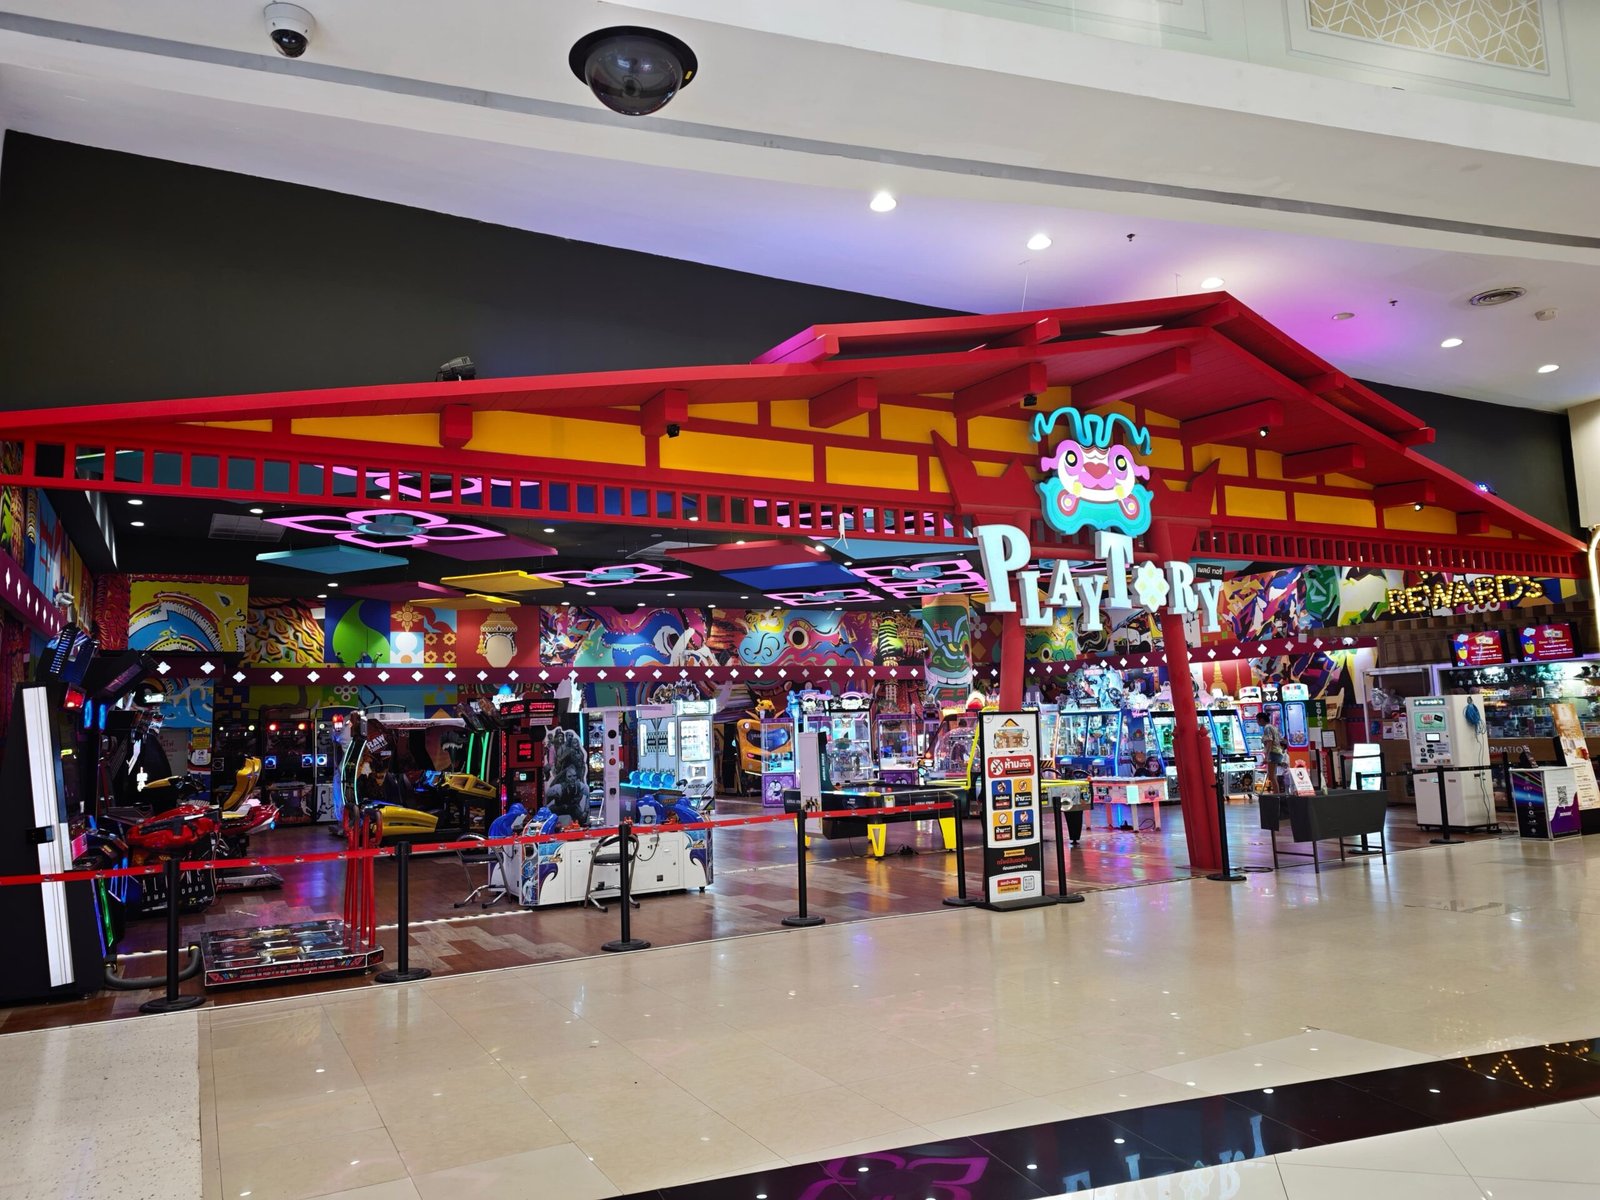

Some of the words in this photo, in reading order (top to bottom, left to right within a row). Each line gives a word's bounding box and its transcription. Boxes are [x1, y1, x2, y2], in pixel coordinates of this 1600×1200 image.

[1387, 575, 1544, 615] REWARDS
[366, 734, 385, 750] RAW
[142, 869, 203, 893] ALINS
